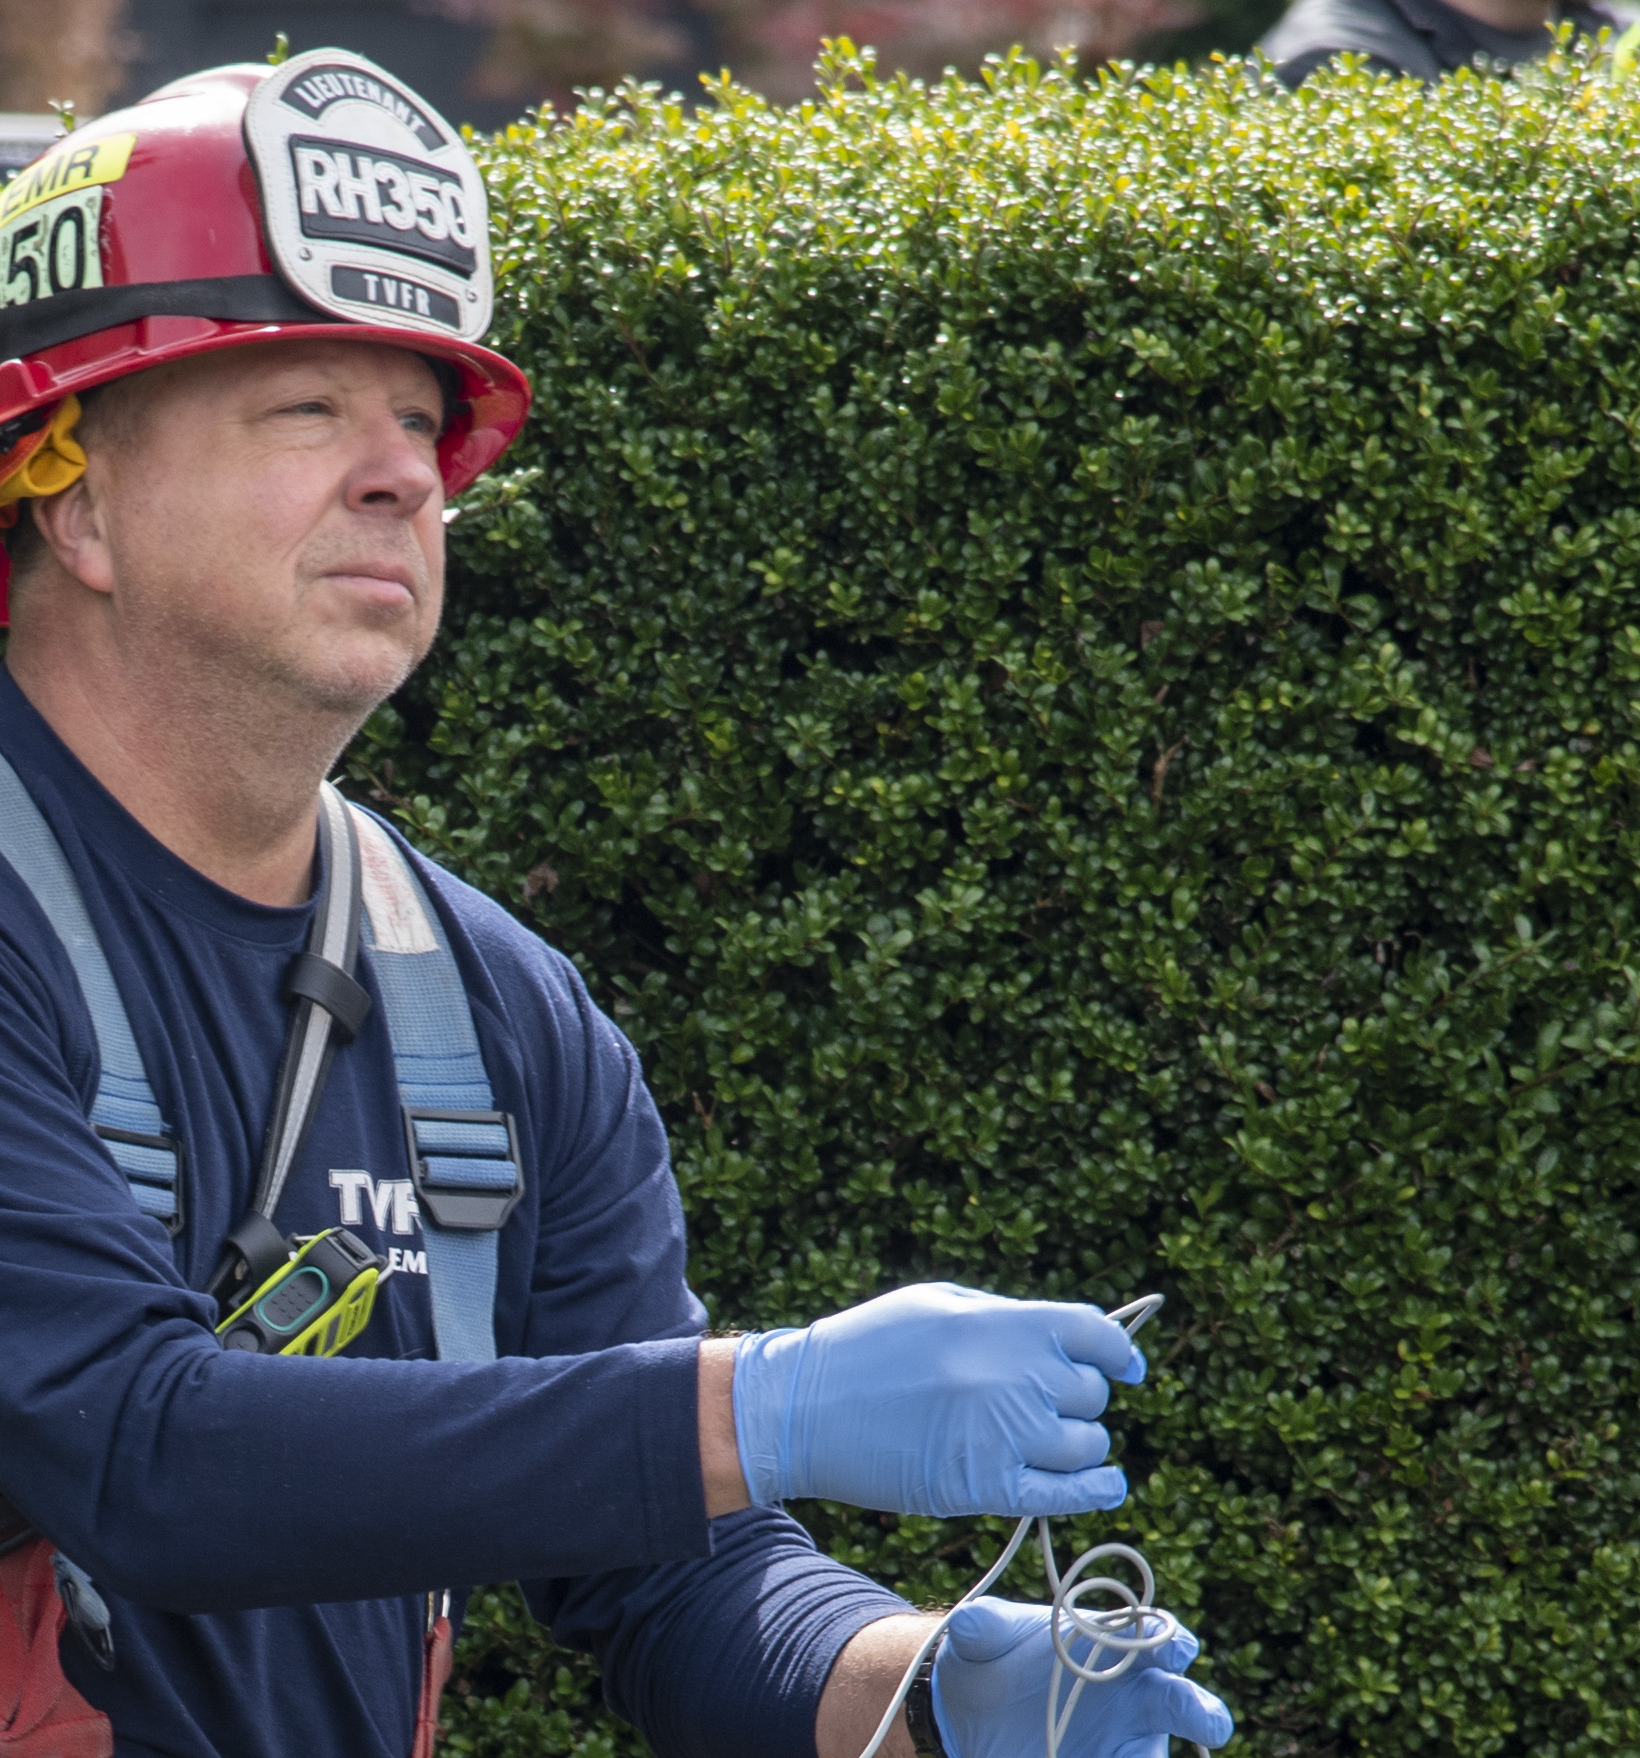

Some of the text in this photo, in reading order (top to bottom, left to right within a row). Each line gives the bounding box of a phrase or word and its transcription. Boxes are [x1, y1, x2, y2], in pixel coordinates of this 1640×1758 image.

[294, 73, 427, 132] LIEUTENANT
[1, 145, 100, 220] EMR
[294, 147, 476, 250] RH350
[362, 273, 432, 317] TVFR
[328, 1168, 422, 1236] TVF
